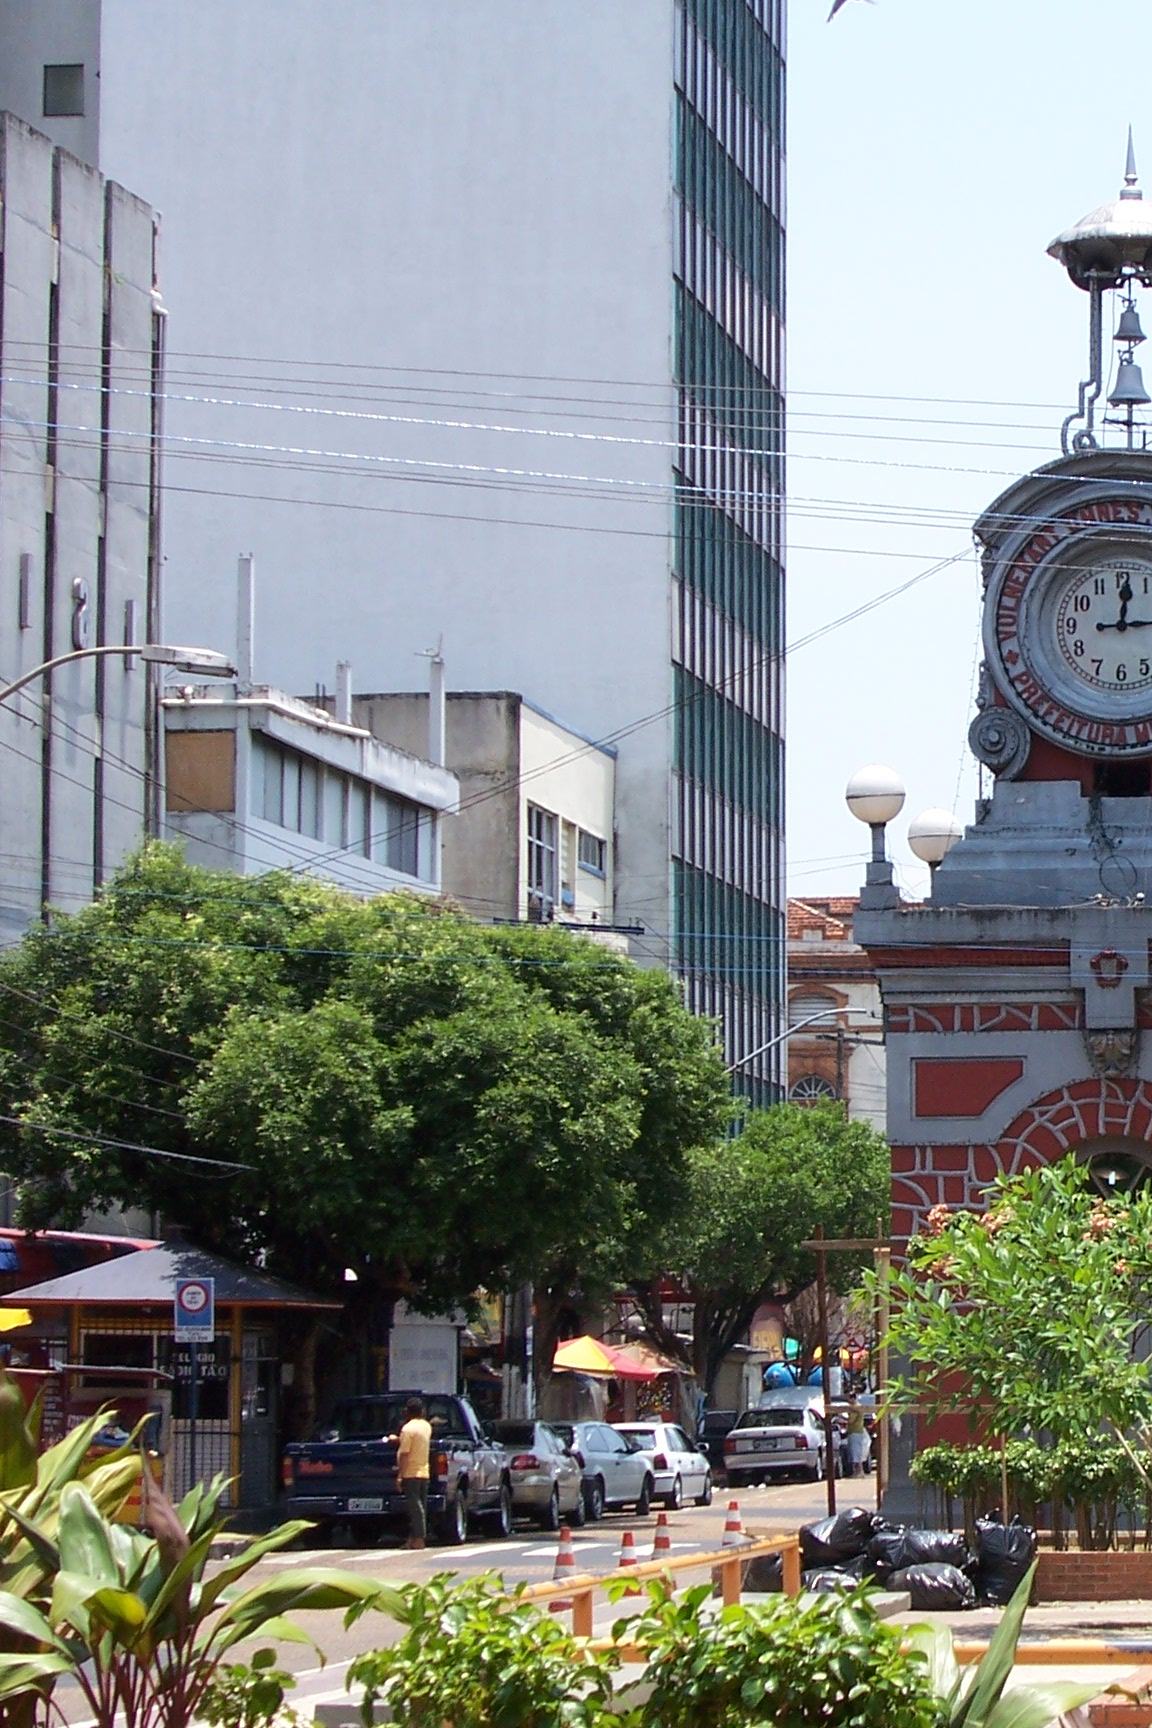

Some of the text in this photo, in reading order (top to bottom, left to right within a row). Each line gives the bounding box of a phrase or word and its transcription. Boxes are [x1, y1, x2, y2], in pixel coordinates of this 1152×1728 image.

[1094, 578, 1105, 595] 11
[1116, 572, 1131, 589] 12
[1143, 577, 1148, 594] 1
[1074, 595, 1091, 612] 10
[1066, 617, 1077, 635] 9
[1073, 639, 1085, 657] 8
[1091, 659, 1104, 676] 7
[1116, 664, 1126, 681] 6
[1139, 659, 1150, 676] 5
[1012, 671, 1127, 744] PREFEITURA
